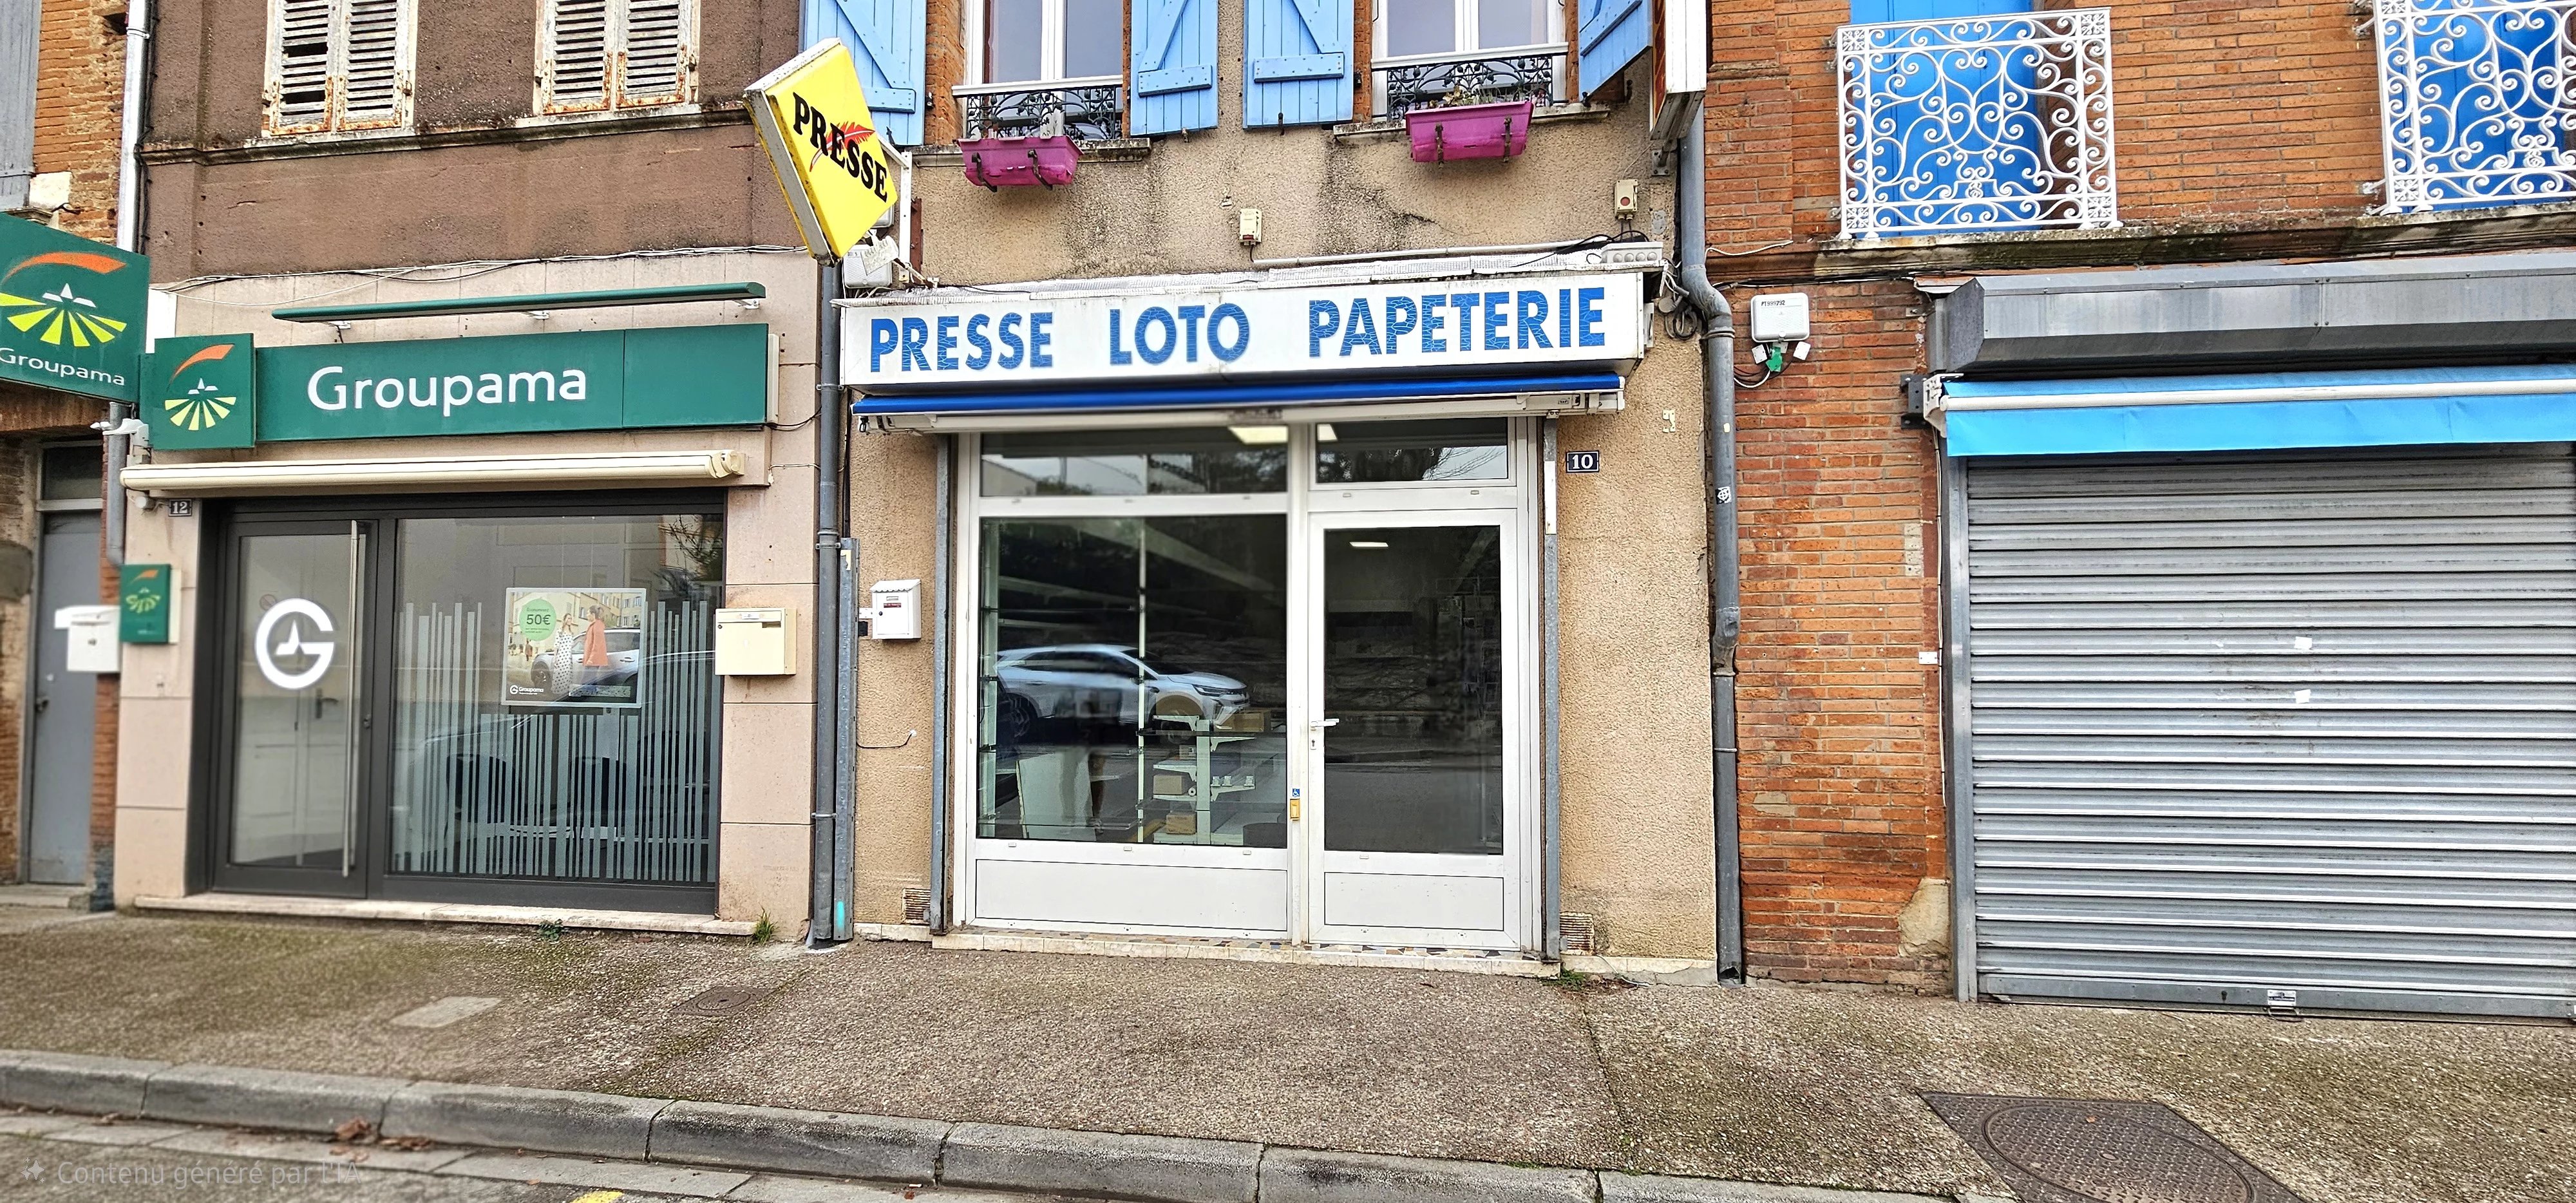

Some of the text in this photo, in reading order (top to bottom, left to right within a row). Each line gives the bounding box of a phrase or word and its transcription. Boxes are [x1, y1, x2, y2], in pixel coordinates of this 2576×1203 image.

[793, 92, 888, 202] PRESSE
[871, 287, 1605, 372] PRESSE LOTO PAPETERIE
[0, 348, 125, 386] Groupama
[308, 366, 586, 417] Groupama
[1572, 454, 1593, 469] 10
[173, 502, 187, 514] 12
[526, 614, 551, 625] 50€
